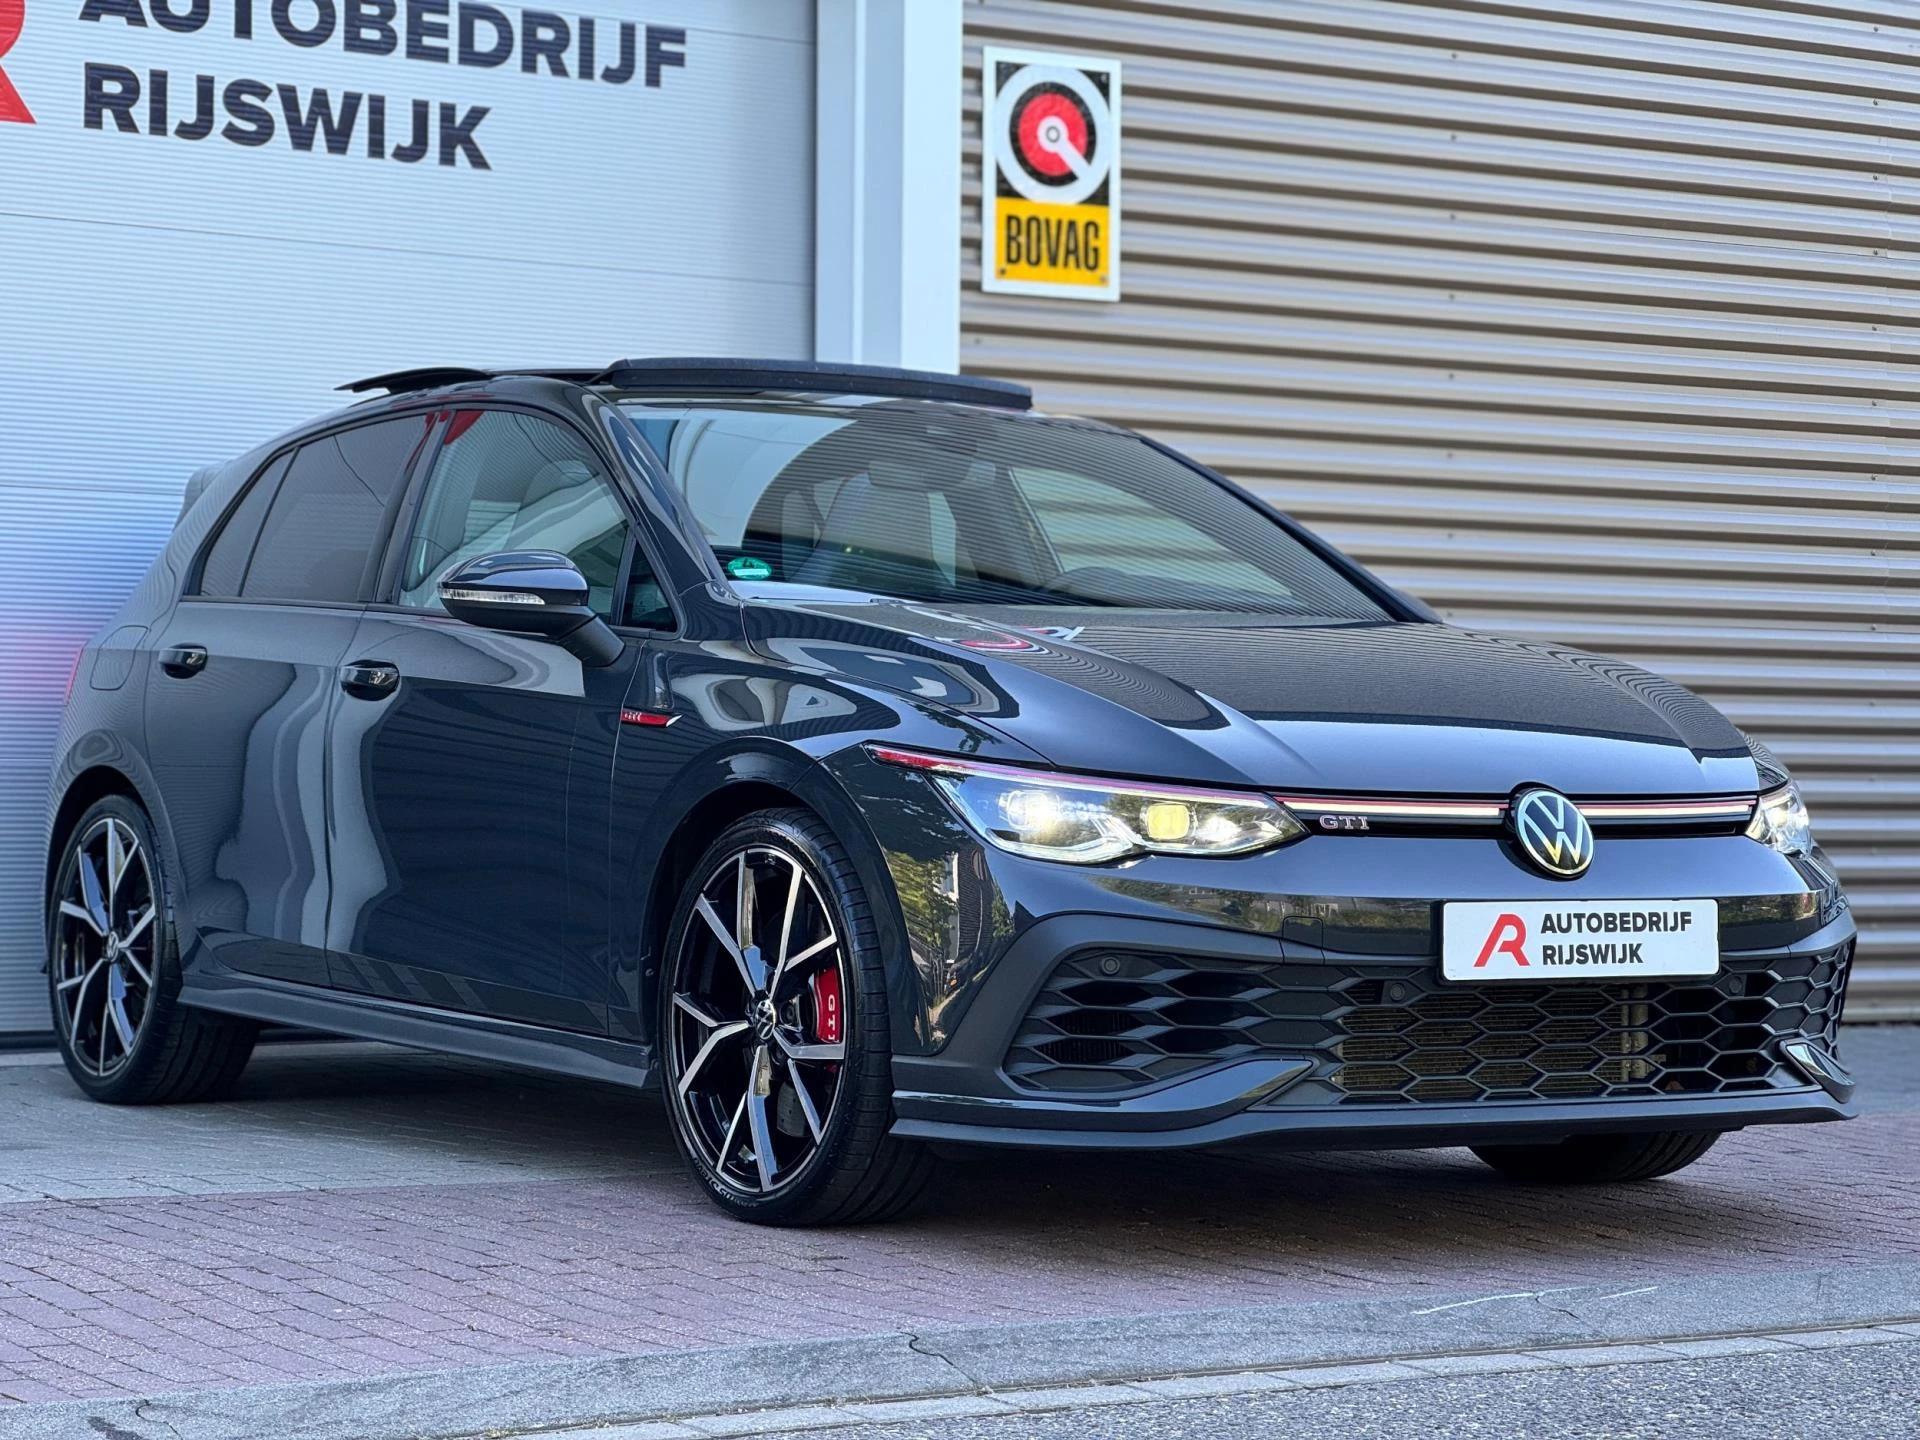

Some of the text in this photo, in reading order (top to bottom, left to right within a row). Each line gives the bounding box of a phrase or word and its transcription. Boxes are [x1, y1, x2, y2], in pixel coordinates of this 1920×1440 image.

[83, 62, 493, 171] RIJSWIJK
[1005, 214, 1100, 272] BOVAG
[1319, 814, 1370, 830] GTI
[1519, 793, 1590, 870] VW
[1540, 911, 1692, 934] AUTOBEDRIJF
[1542, 943, 1644, 966] RIJSWIJK
